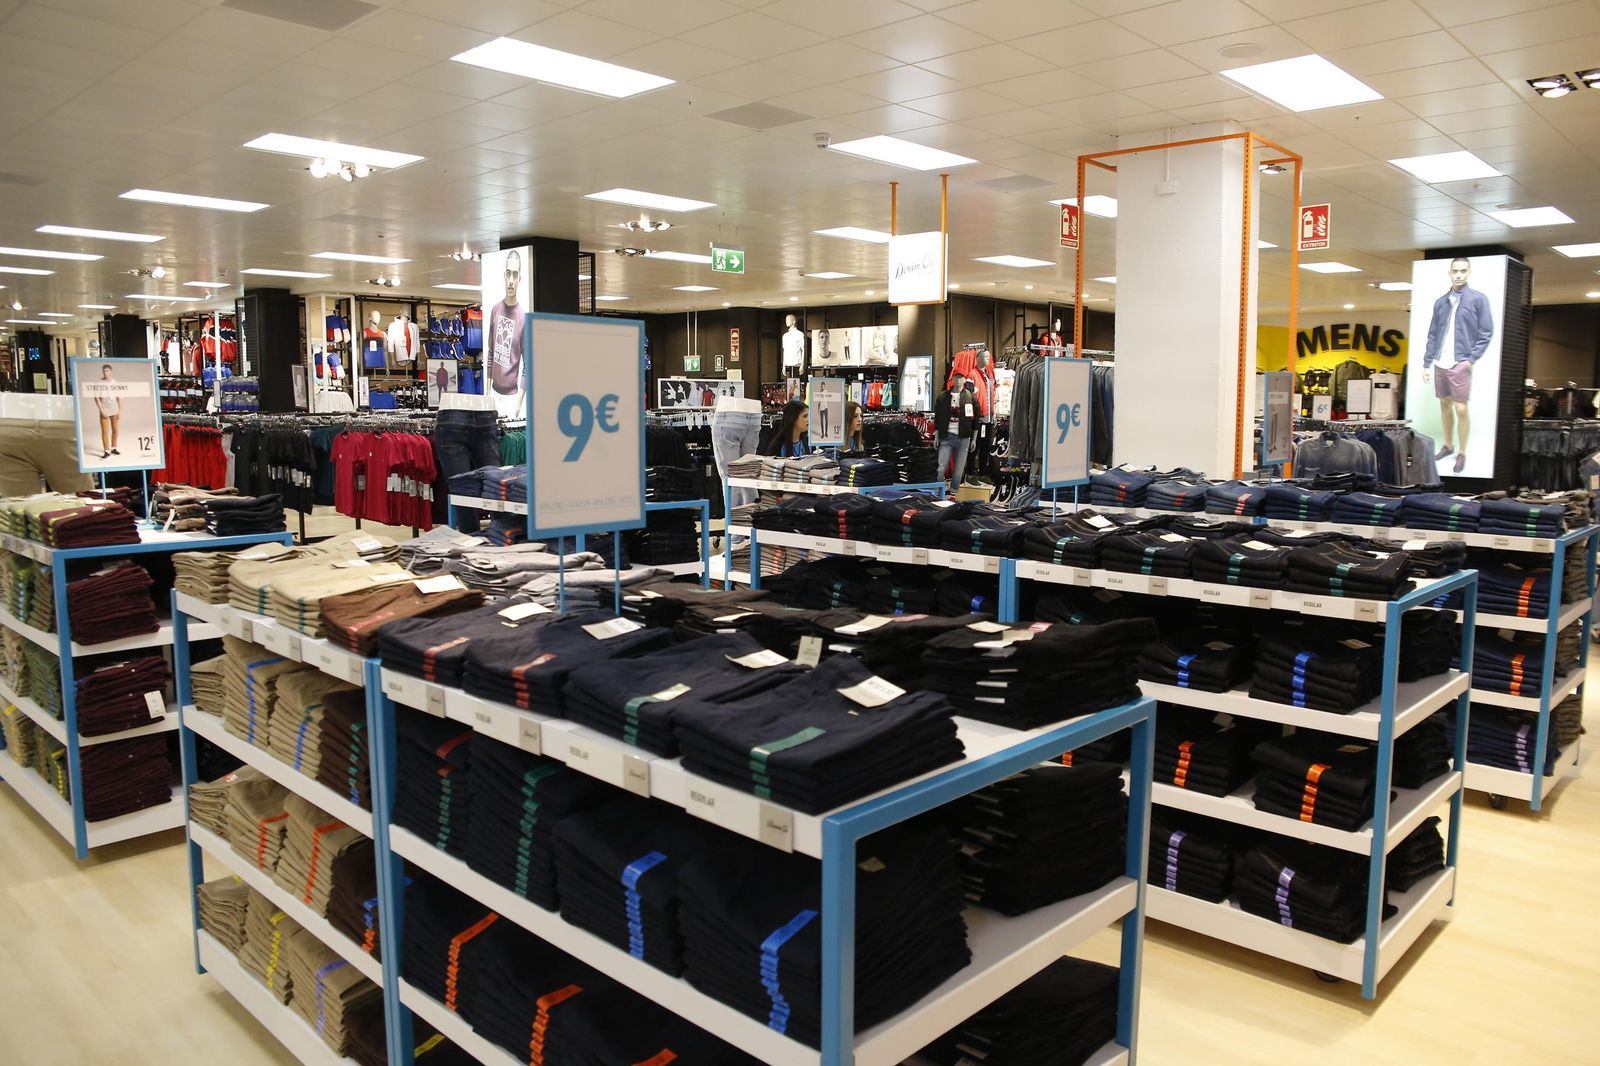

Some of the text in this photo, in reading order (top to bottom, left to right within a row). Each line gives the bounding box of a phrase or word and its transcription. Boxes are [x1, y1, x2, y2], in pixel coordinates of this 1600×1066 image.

[1296, 323, 1405, 358] MENS
[557, 393, 620, 463] 9€
[1056, 403, 1081, 444] 9€
[137, 435, 155, 451] 12€
[1203, 589, 1221, 597] REGULAR
[1303, 601, 1323, 609] REGULAR
[690, 790, 716, 807] REGULAR
